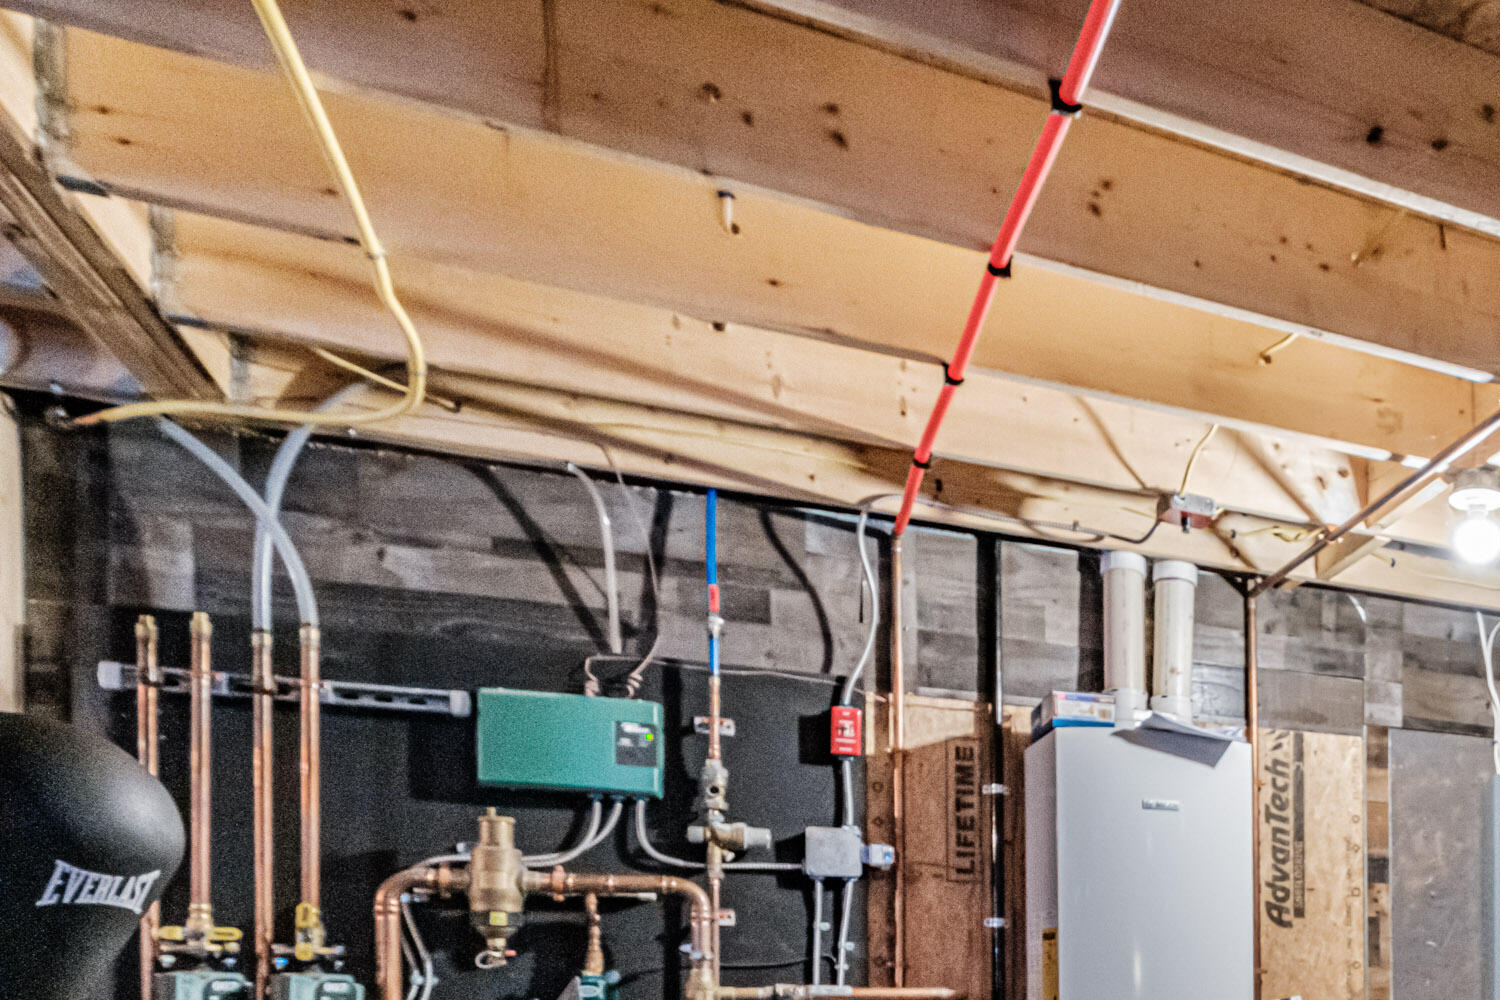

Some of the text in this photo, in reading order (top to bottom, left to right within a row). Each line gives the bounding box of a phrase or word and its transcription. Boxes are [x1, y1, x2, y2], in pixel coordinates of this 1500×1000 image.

[955, 746, 975, 875] LIFETIME
[1264, 758, 1293, 929] AdvanTech
[35, 859, 161, 915] EVERLAST
